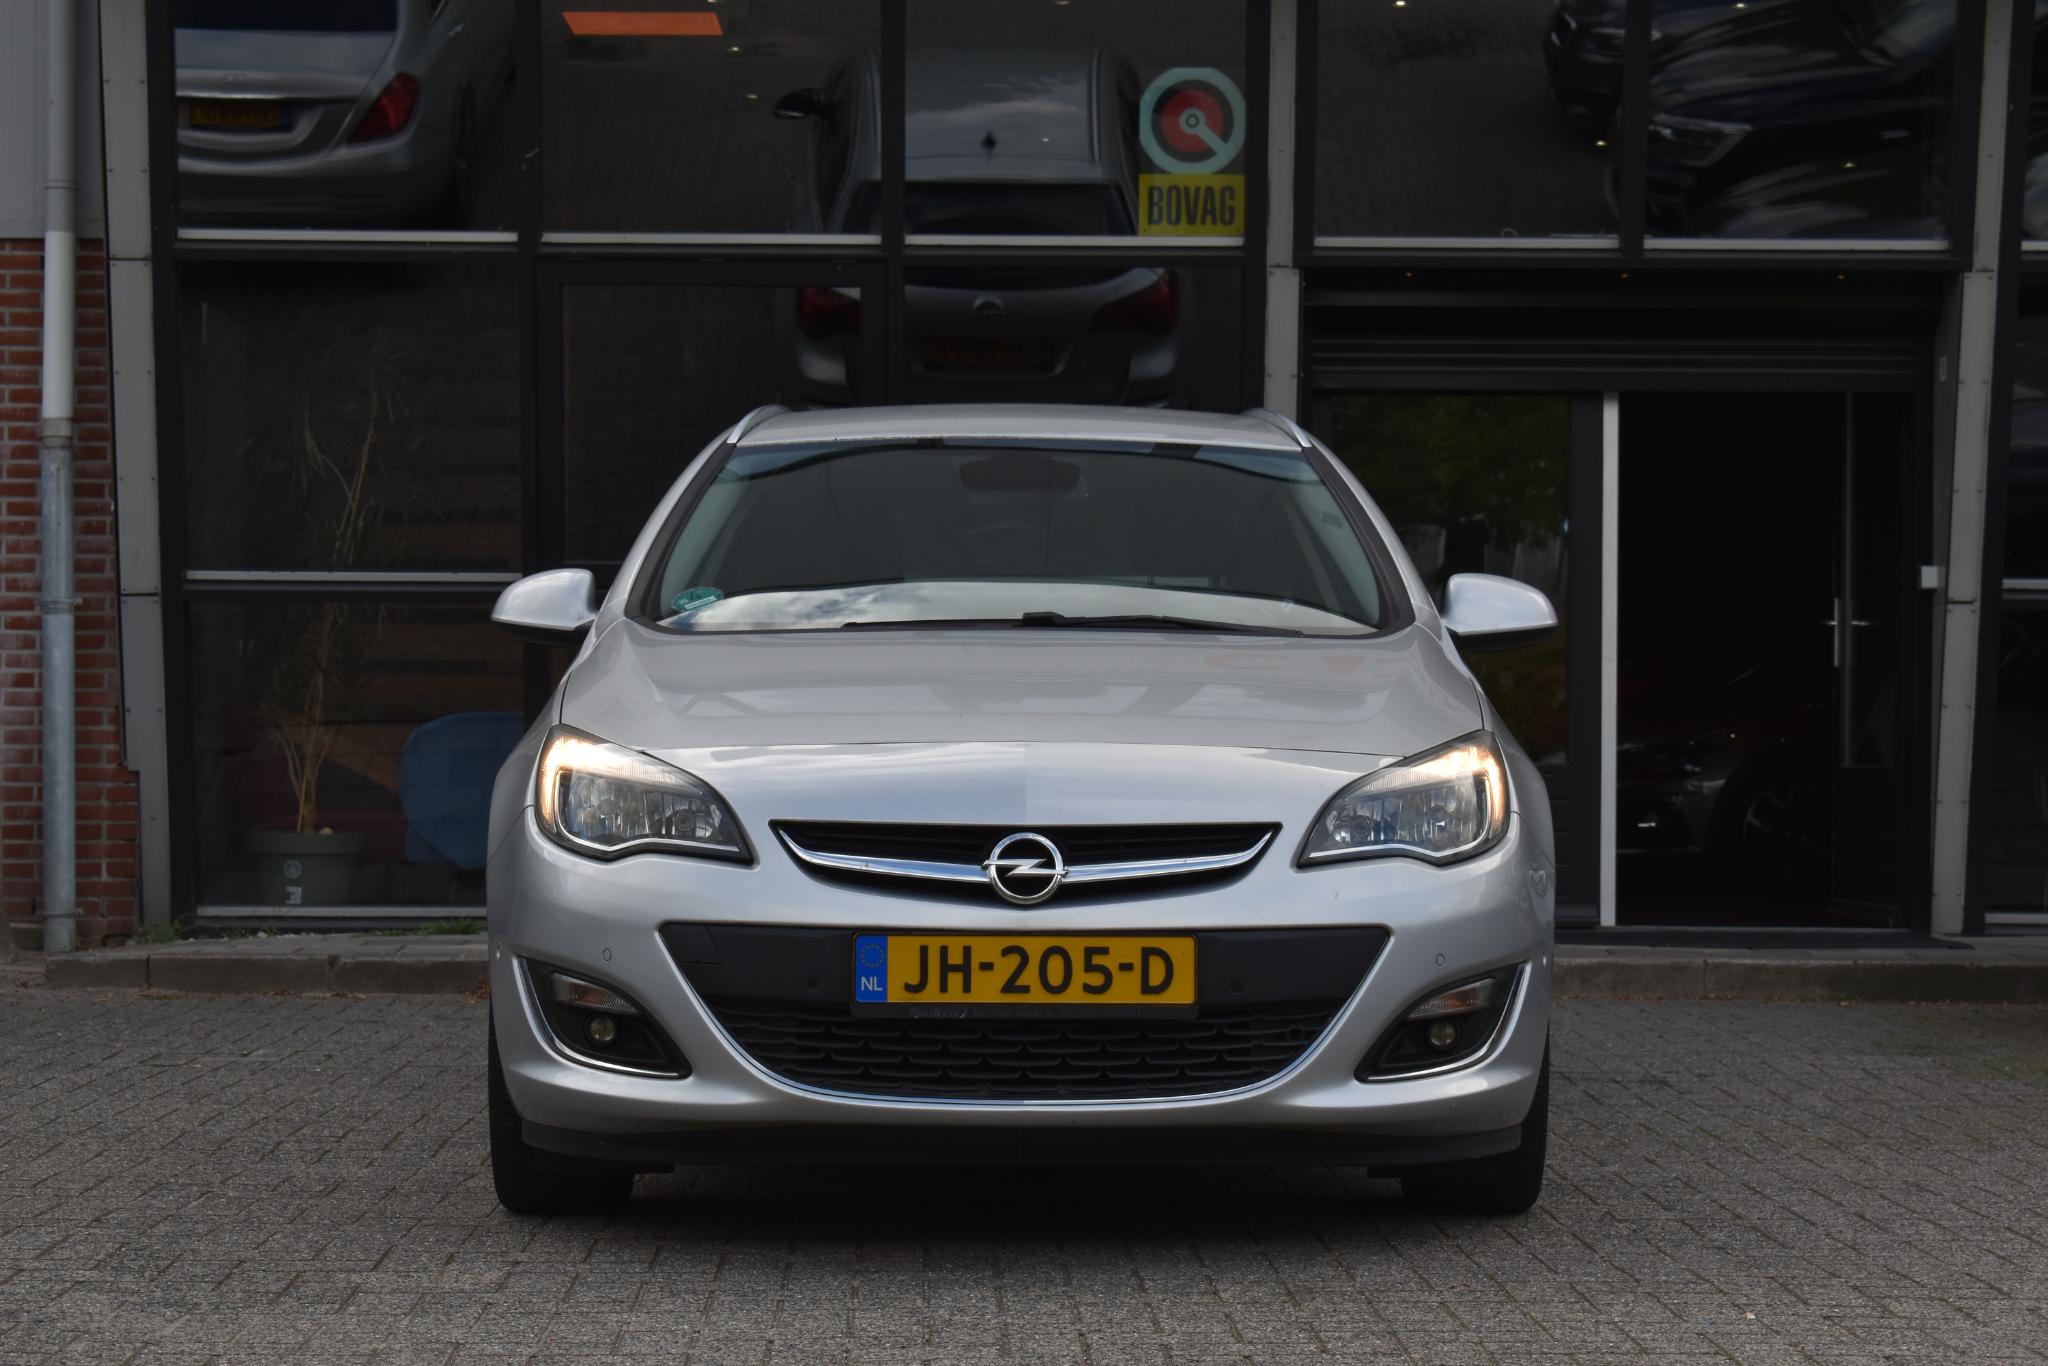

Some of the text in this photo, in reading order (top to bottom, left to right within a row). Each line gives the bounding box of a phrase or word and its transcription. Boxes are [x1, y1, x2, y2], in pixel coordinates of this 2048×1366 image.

[1148, 185, 1236, 227] BOVAG
[860, 975, 884, 992] NL
[903, 944, 1175, 996] JH-205-D
